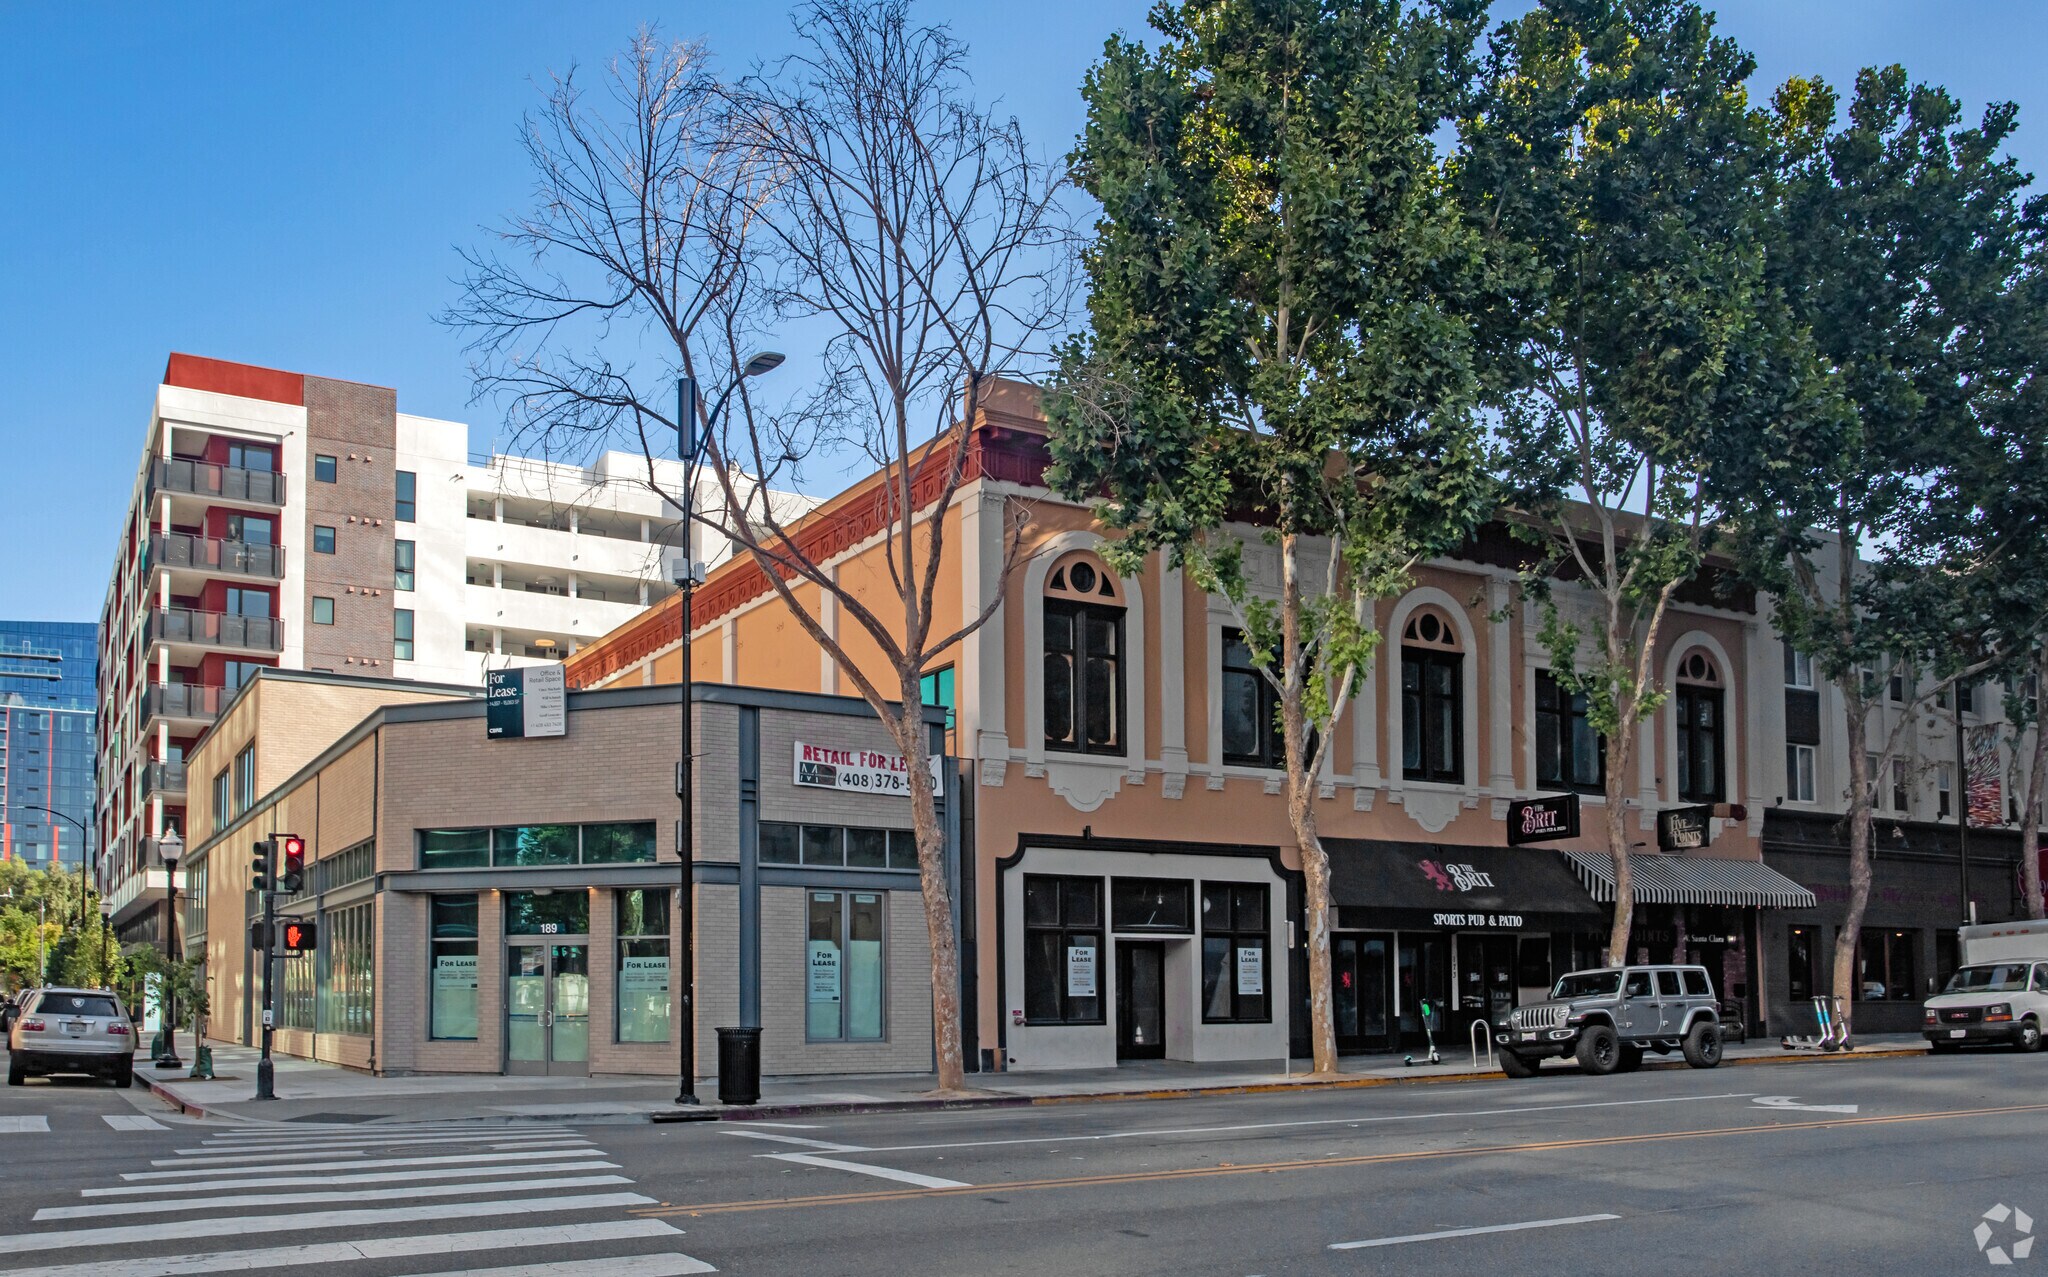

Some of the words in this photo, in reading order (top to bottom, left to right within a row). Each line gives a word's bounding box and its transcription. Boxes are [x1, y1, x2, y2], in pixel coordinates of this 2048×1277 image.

[489, 673, 505, 684] For
[489, 686, 517, 698] Lease
[803, 745, 855, 766] RETAIL
[860, 752, 887, 769] FOR
[1521, 806, 1557, 834] BRIT
[1458, 864, 1475, 872] THE
[1446, 864, 1495, 892] BRIT
[1433, 913, 1466, 926] SPORTS
[1468, 914, 1485, 926] PUB
[1488, 915, 1497, 927] &
[1498, 915, 1523, 927] PATIO
[540, 923, 558, 934] 189
[817, 951, 832, 959] FOR
[626, 961, 641, 969] FOR
[644, 961, 666, 969] LEASE
[812, 959, 836, 967] LEASE
